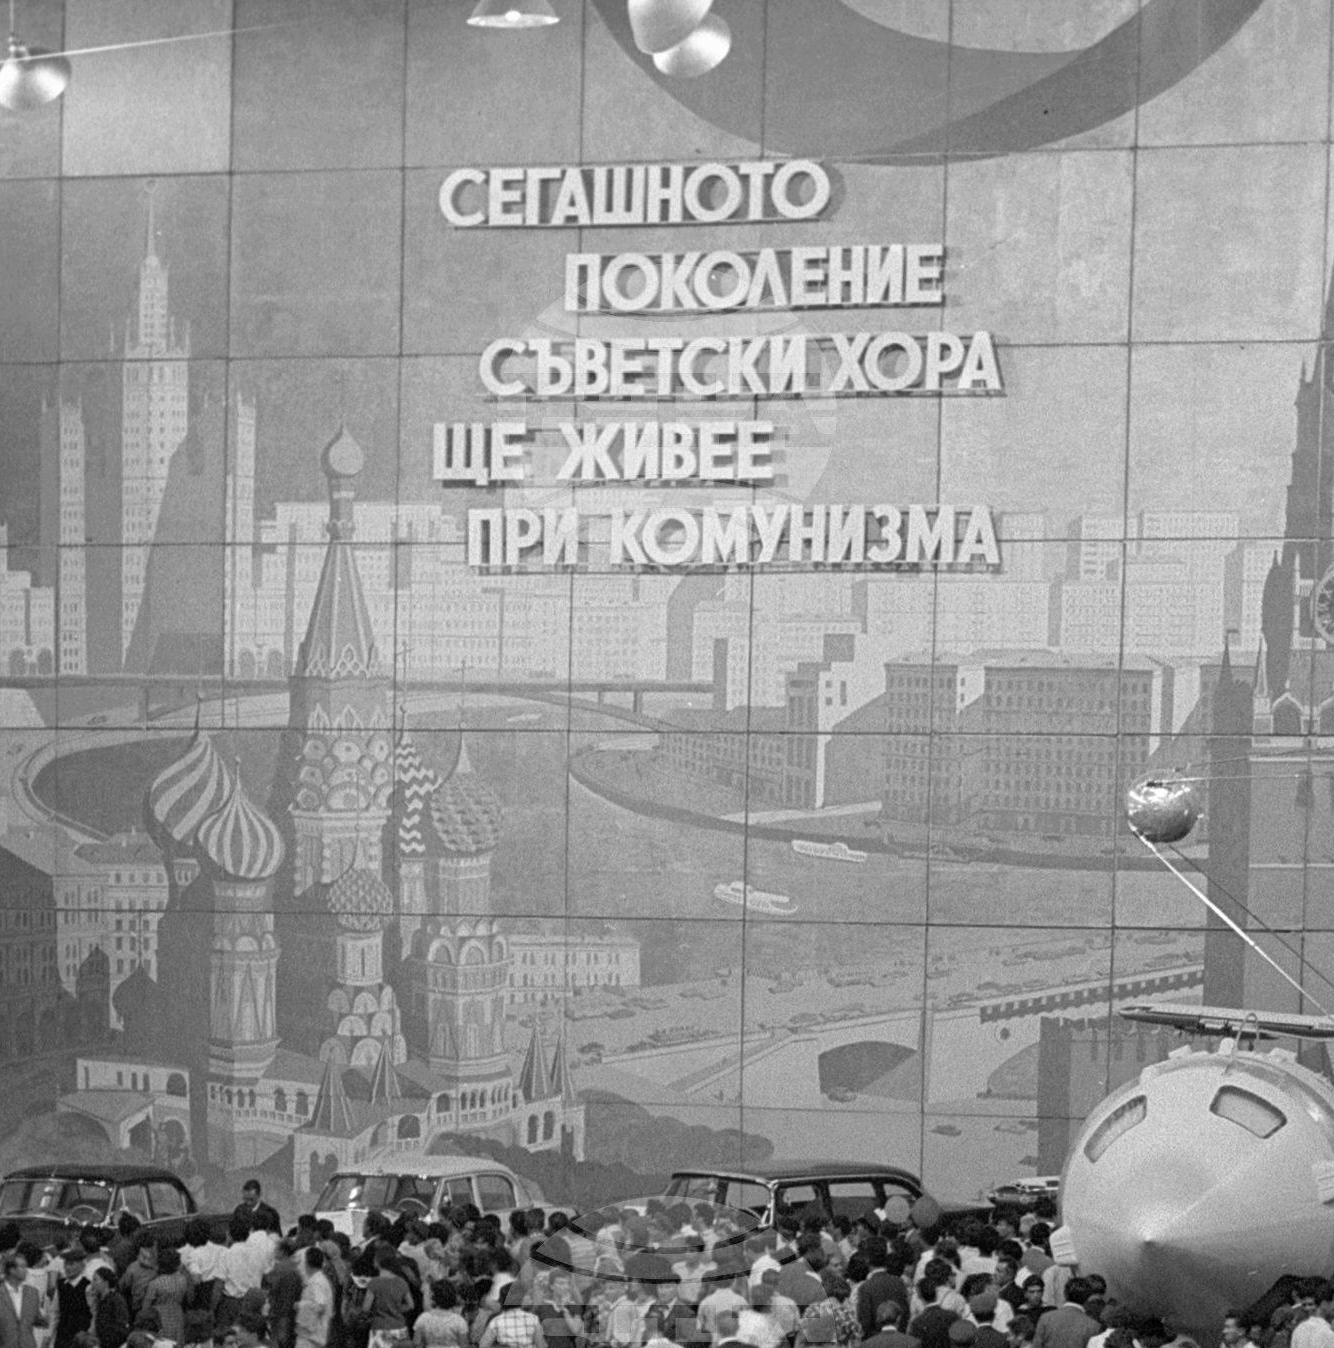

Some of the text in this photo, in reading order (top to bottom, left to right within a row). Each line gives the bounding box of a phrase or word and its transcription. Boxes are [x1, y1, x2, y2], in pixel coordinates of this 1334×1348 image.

[438, 159, 832, 227] СЕГАШНОТО
[565, 243, 944, 312] ПОКОЛЕНИЕ
[478, 330, 1003, 396] СЪВЕТСКИ ХОРА
[432, 420, 774, 486] ЩЕ ЖИВЕЕ
[468, 503, 1002, 567] ПРИ КОМУНИЗМА
